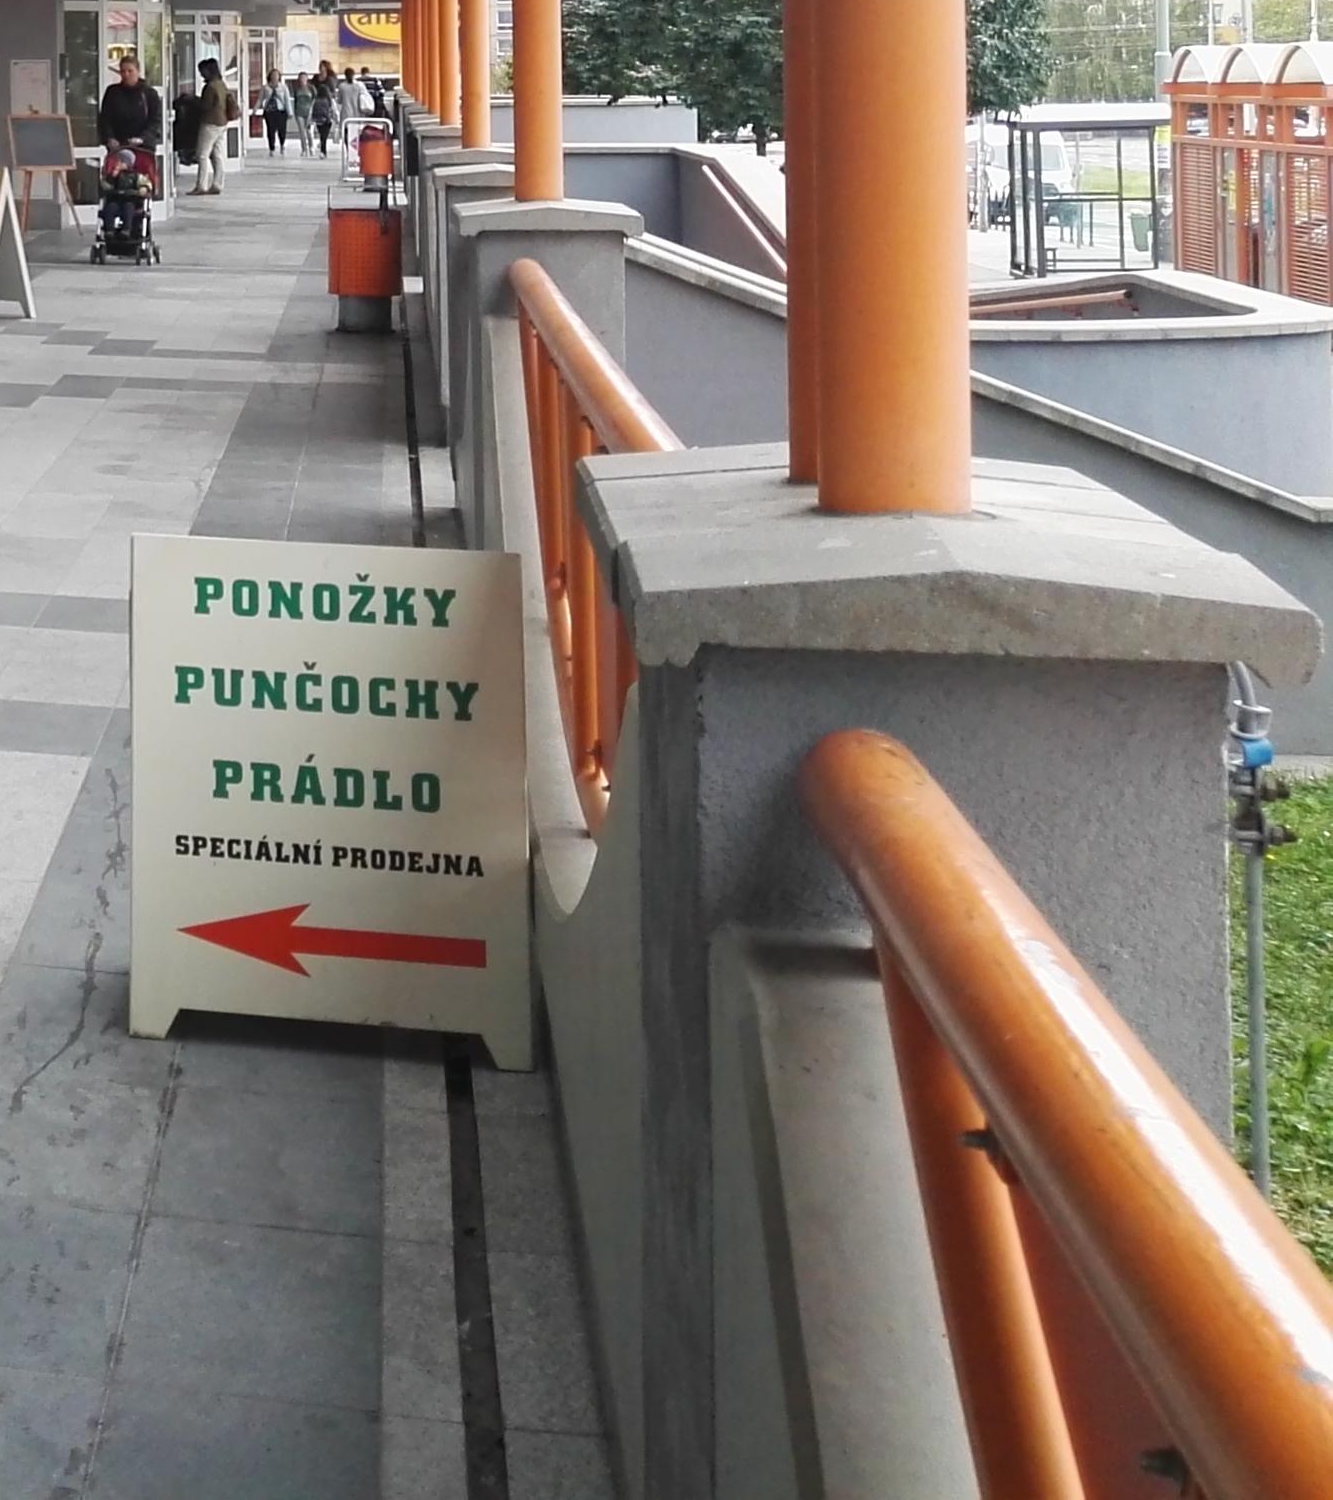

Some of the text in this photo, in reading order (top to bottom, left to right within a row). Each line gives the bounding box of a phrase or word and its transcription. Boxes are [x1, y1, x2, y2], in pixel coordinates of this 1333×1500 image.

[193, 572, 456, 628] PONOŽKY
[174, 661, 479, 721] PUNČOCHY
[212, 753, 441, 813] PRÁDLO
[175, 834, 484, 877] SPECIÁLNÍ PRODEJNA
